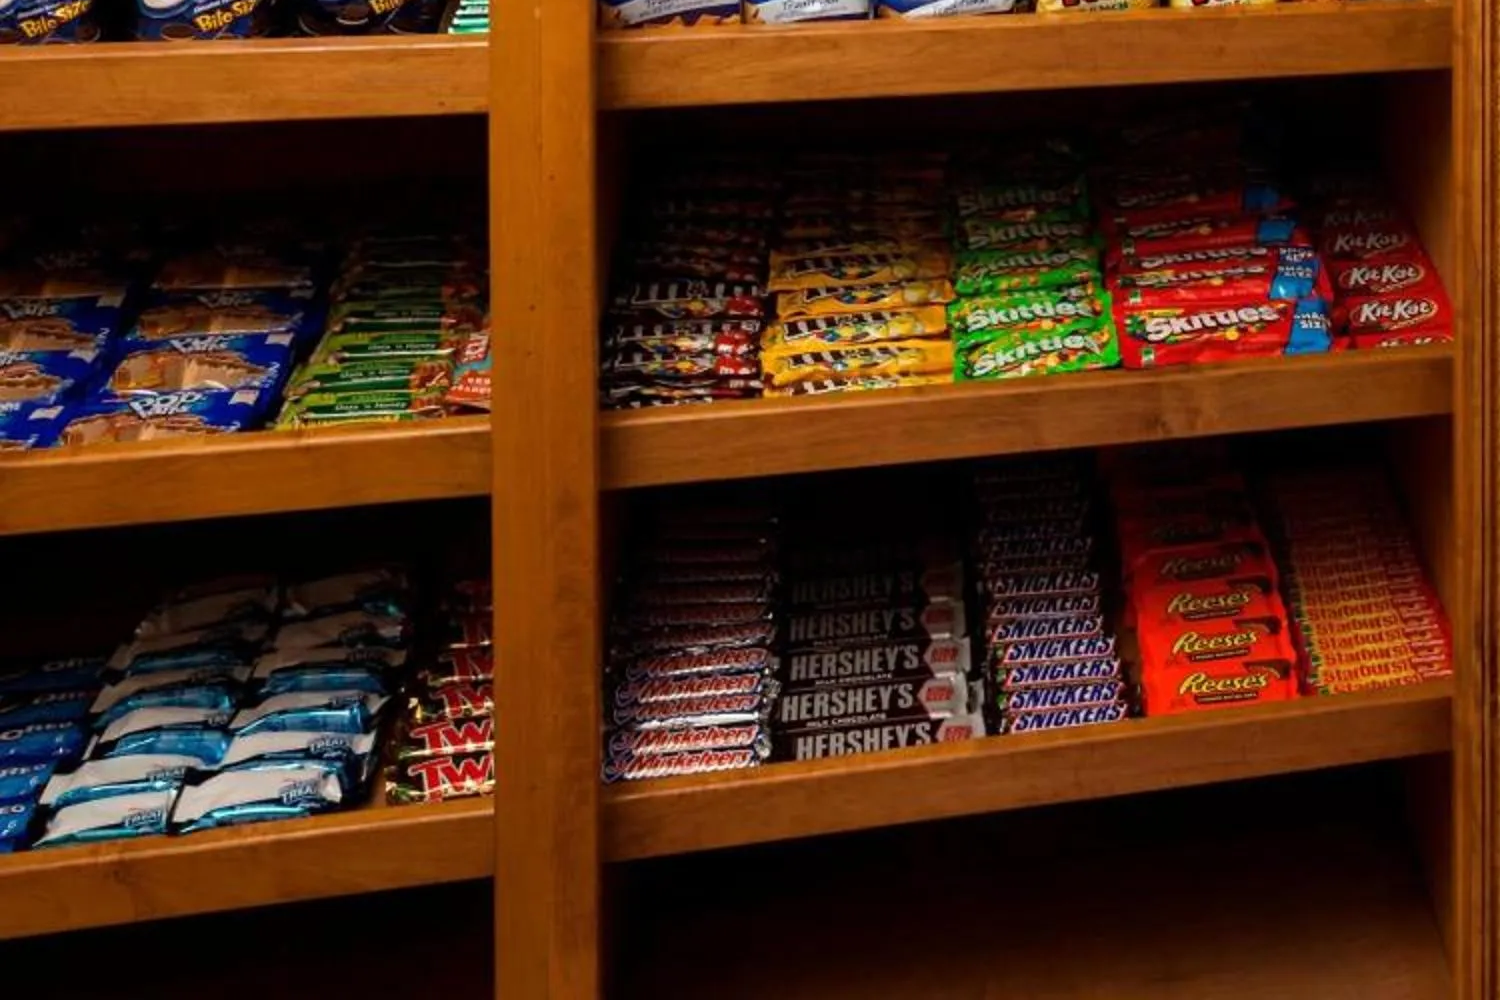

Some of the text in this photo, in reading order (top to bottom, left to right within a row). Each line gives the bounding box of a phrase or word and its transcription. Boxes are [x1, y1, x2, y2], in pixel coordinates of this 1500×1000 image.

[967, 301, 1095, 333] Skittles
[1145, 305, 1281, 342] Skittles
[972, 335, 1101, 377] Skittles
[996, 617, 1101, 640] SNICKERS
[789, 645, 919, 682] HERSHEY'S
[1008, 637, 1112, 661] SNICKERS
[1012, 659, 1117, 683] SNICKERS
[781, 683, 914, 723] HERSHEY'S
[1011, 682, 1119, 709] SNICKERS
[1015, 705, 1123, 730] SNICKERS
[408, 720, 494, 752] TW
[797, 722, 931, 761] HERSHEY'S
[406, 754, 494, 802] TW
